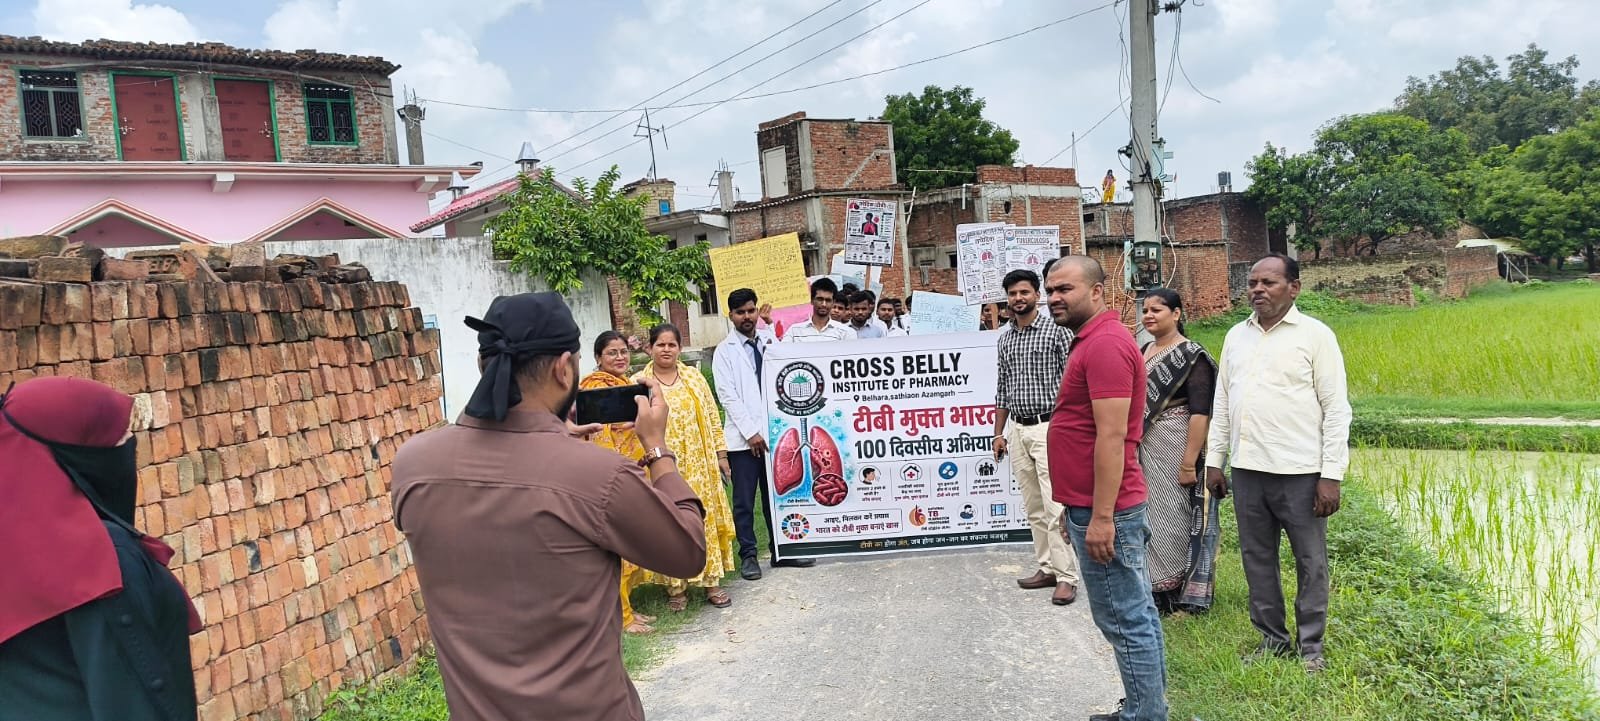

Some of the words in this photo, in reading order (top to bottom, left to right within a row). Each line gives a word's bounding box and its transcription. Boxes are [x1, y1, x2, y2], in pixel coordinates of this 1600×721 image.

[830, 356, 895, 379] CROSS
[902, 352, 962, 375] BELLY
[832, 379, 889, 393] INSTITUTE
[892, 379, 906, 390] OF
[909, 374, 969, 389] PHARMACY
[921, 390, 956, 400] Azamgarh
[853, 405, 895, 434] टीबी
[900, 407, 945, 436] मुक्त
[855, 440, 886, 459] 100
[889, 435, 943, 458] दिवसीय
[946, 432, 994, 453] अभिया
[832, 524, 840, 533] को
[841, 523, 854, 532] टीबी
